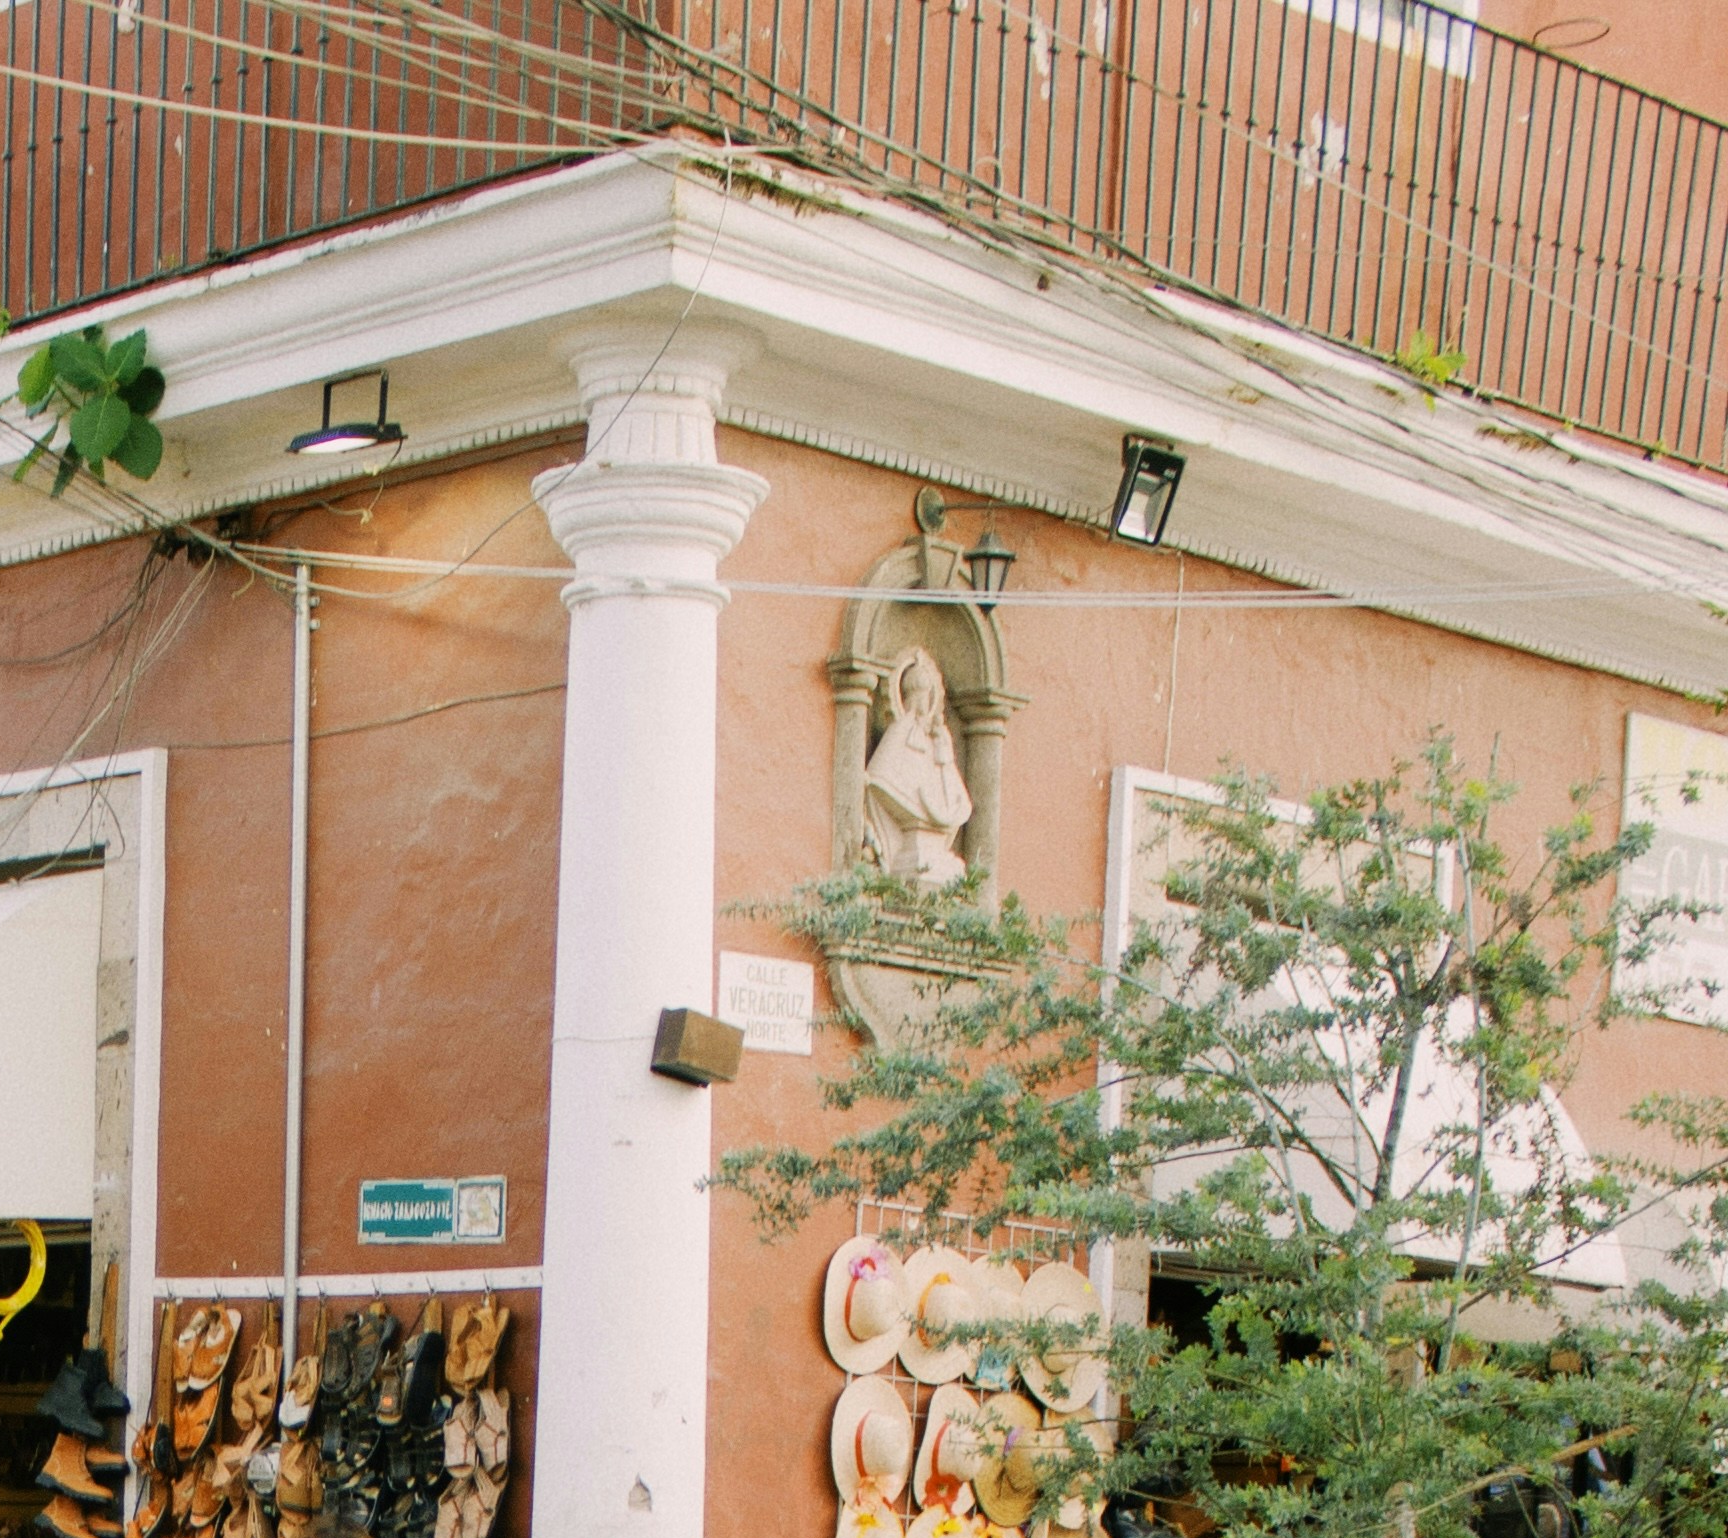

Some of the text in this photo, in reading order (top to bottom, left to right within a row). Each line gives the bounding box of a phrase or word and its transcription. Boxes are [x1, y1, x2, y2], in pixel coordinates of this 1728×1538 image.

[746, 964, 788, 986] CALLE
[729, 986, 805, 1020] VERACRUZ
[746, 1019, 787, 1042] NORTE
